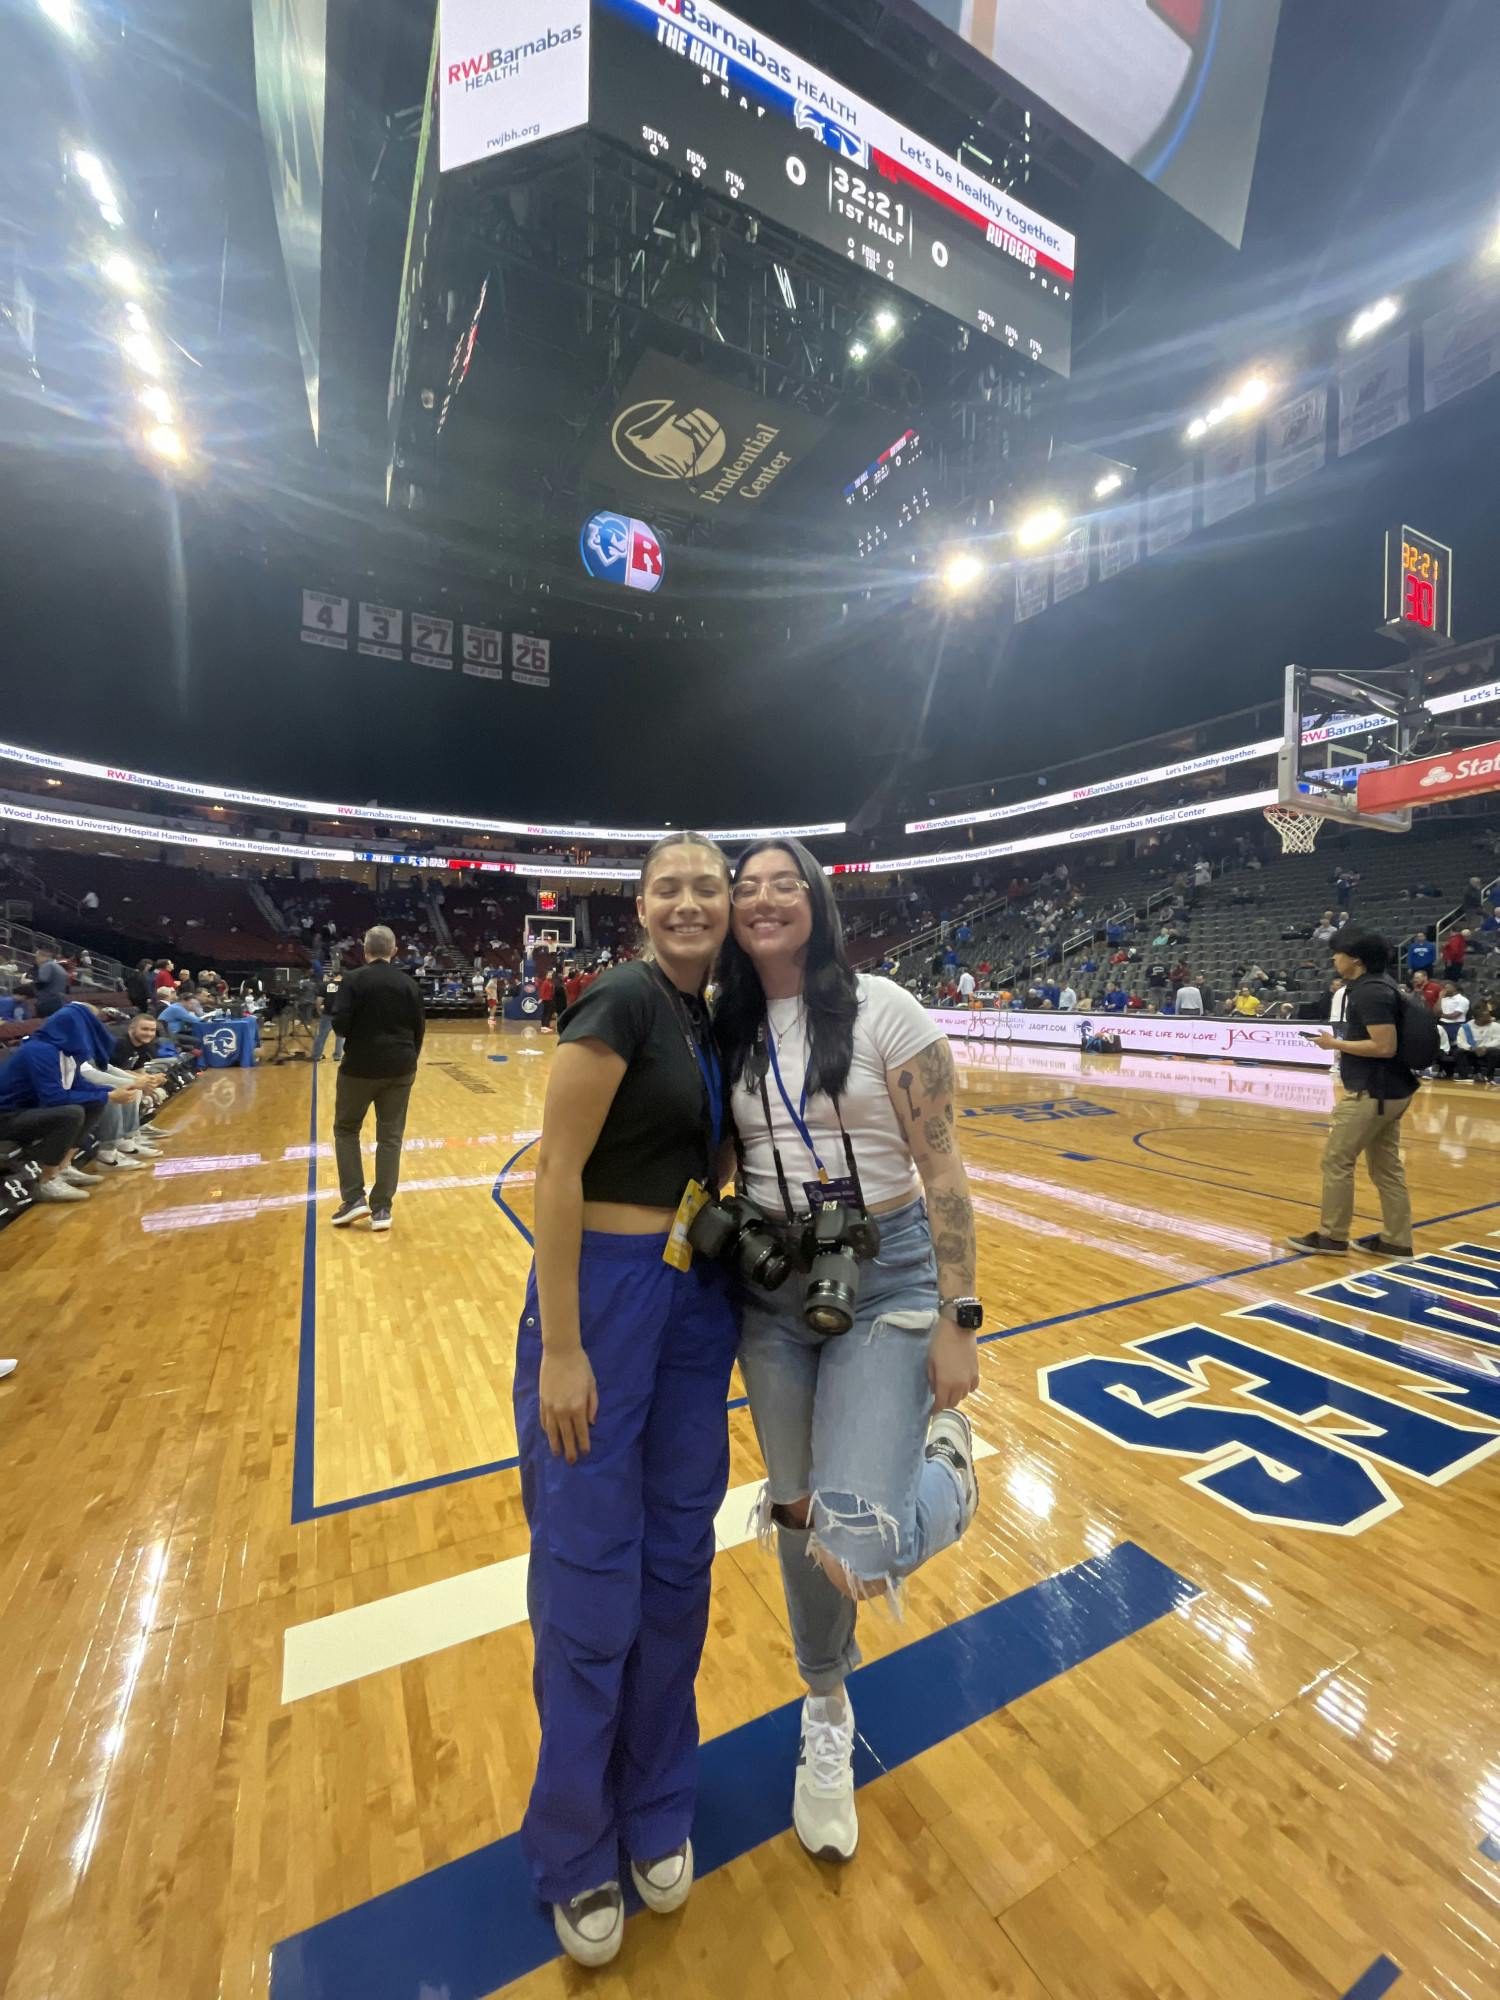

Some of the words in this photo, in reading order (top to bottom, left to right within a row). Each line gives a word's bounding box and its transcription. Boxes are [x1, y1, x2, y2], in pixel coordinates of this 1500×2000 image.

[448, 24, 583, 86] RWJBarnabas
[657, 17, 688, 56] THE
[689, 38, 729, 82] HALL
[465, 61, 520, 93] HEALTH
[797, 76, 857, 126] HEALTH
[486, 123, 541, 149] rwjbh.org
[642, 125, 669, 150] 3PT%
[725, 169, 745, 191] FT%
[649, 143, 659, 156] 0
[691, 165, 701, 178] 0
[730, 186, 738, 199] 0
[785, 155, 807, 186] 0
[833, 166, 904, 227] 32:21
[900, 137, 932, 170] Let's
[936, 160, 953, 183] be
[956, 173, 1003, 217] healthy
[1006, 208, 1061, 252] together.
[837, 198, 865, 224] 1ST
[868, 215, 905, 246] HALF
[847, 237, 855, 248] 0
[931, 240, 949, 268] 0
[985, 221, 1038, 269] RUTGERS
[887, 259, 894, 270] 0
[700, 423, 780, 504] Prudential
[739, 451, 792, 498] Center
[1406, 573, 1434, 627] 30
[317, 604, 334, 629] 4
[372, 615, 390, 641] 3
[416, 624, 449, 652] 27
[467, 634, 499, 661] 30
[516, 643, 546, 670] 26
[1464, 686, 1492, 703] Let's
[1301, 716, 1387, 745] RWJBarnabas
[0, 747, 24, 760] ealthy
[1166, 766, 1181, 776] Let's
[1183, 763, 1192, 772] be
[1193, 757, 1220, 770] healthy
[1221, 748, 1257, 763] together.
[1455, 753, 1500, 779] Stat
[107, 770, 175, 790] RWJBarnabas
[176, 786, 205, 795] HEALTH
[1073, 782, 1124, 800] RWJBarnabas
[1124, 776, 1149, 787] HEALTH
[3, 807, 33, 819] Wood
[35, 812, 74, 826] Johnson
[76, 818, 122, 833] University
[124, 827, 160, 839] Hospital
[161, 831, 198, 843] Hamilton
[337, 806, 393, 820] RWJBarnabas
[914, 818, 956, 831] RWJBarnabas
[1070, 826, 1109, 841] Cooperman
[1110, 819, 1143, 832] Barnabas
[1144, 812, 1176, 826] Medical
[1177, 807, 1207, 819] Center
[218, 840, 246, 849] Trinitas
[247, 842, 280, 854] Regional
[281, 846, 310, 856] Medical
[311, 849, 336, 858] Center
[1100, 1026, 1116, 1036] GET
[1117, 1027, 1137, 1036] BACK
[1139, 1029, 1153, 1038] THE
[1155, 1031, 1173, 1039] LIFE
[1175, 1031, 1190, 1040] YOU
[1192, 1031, 1217, 1041] LOVE!
[1221, 1028, 1270, 1050] JAG
